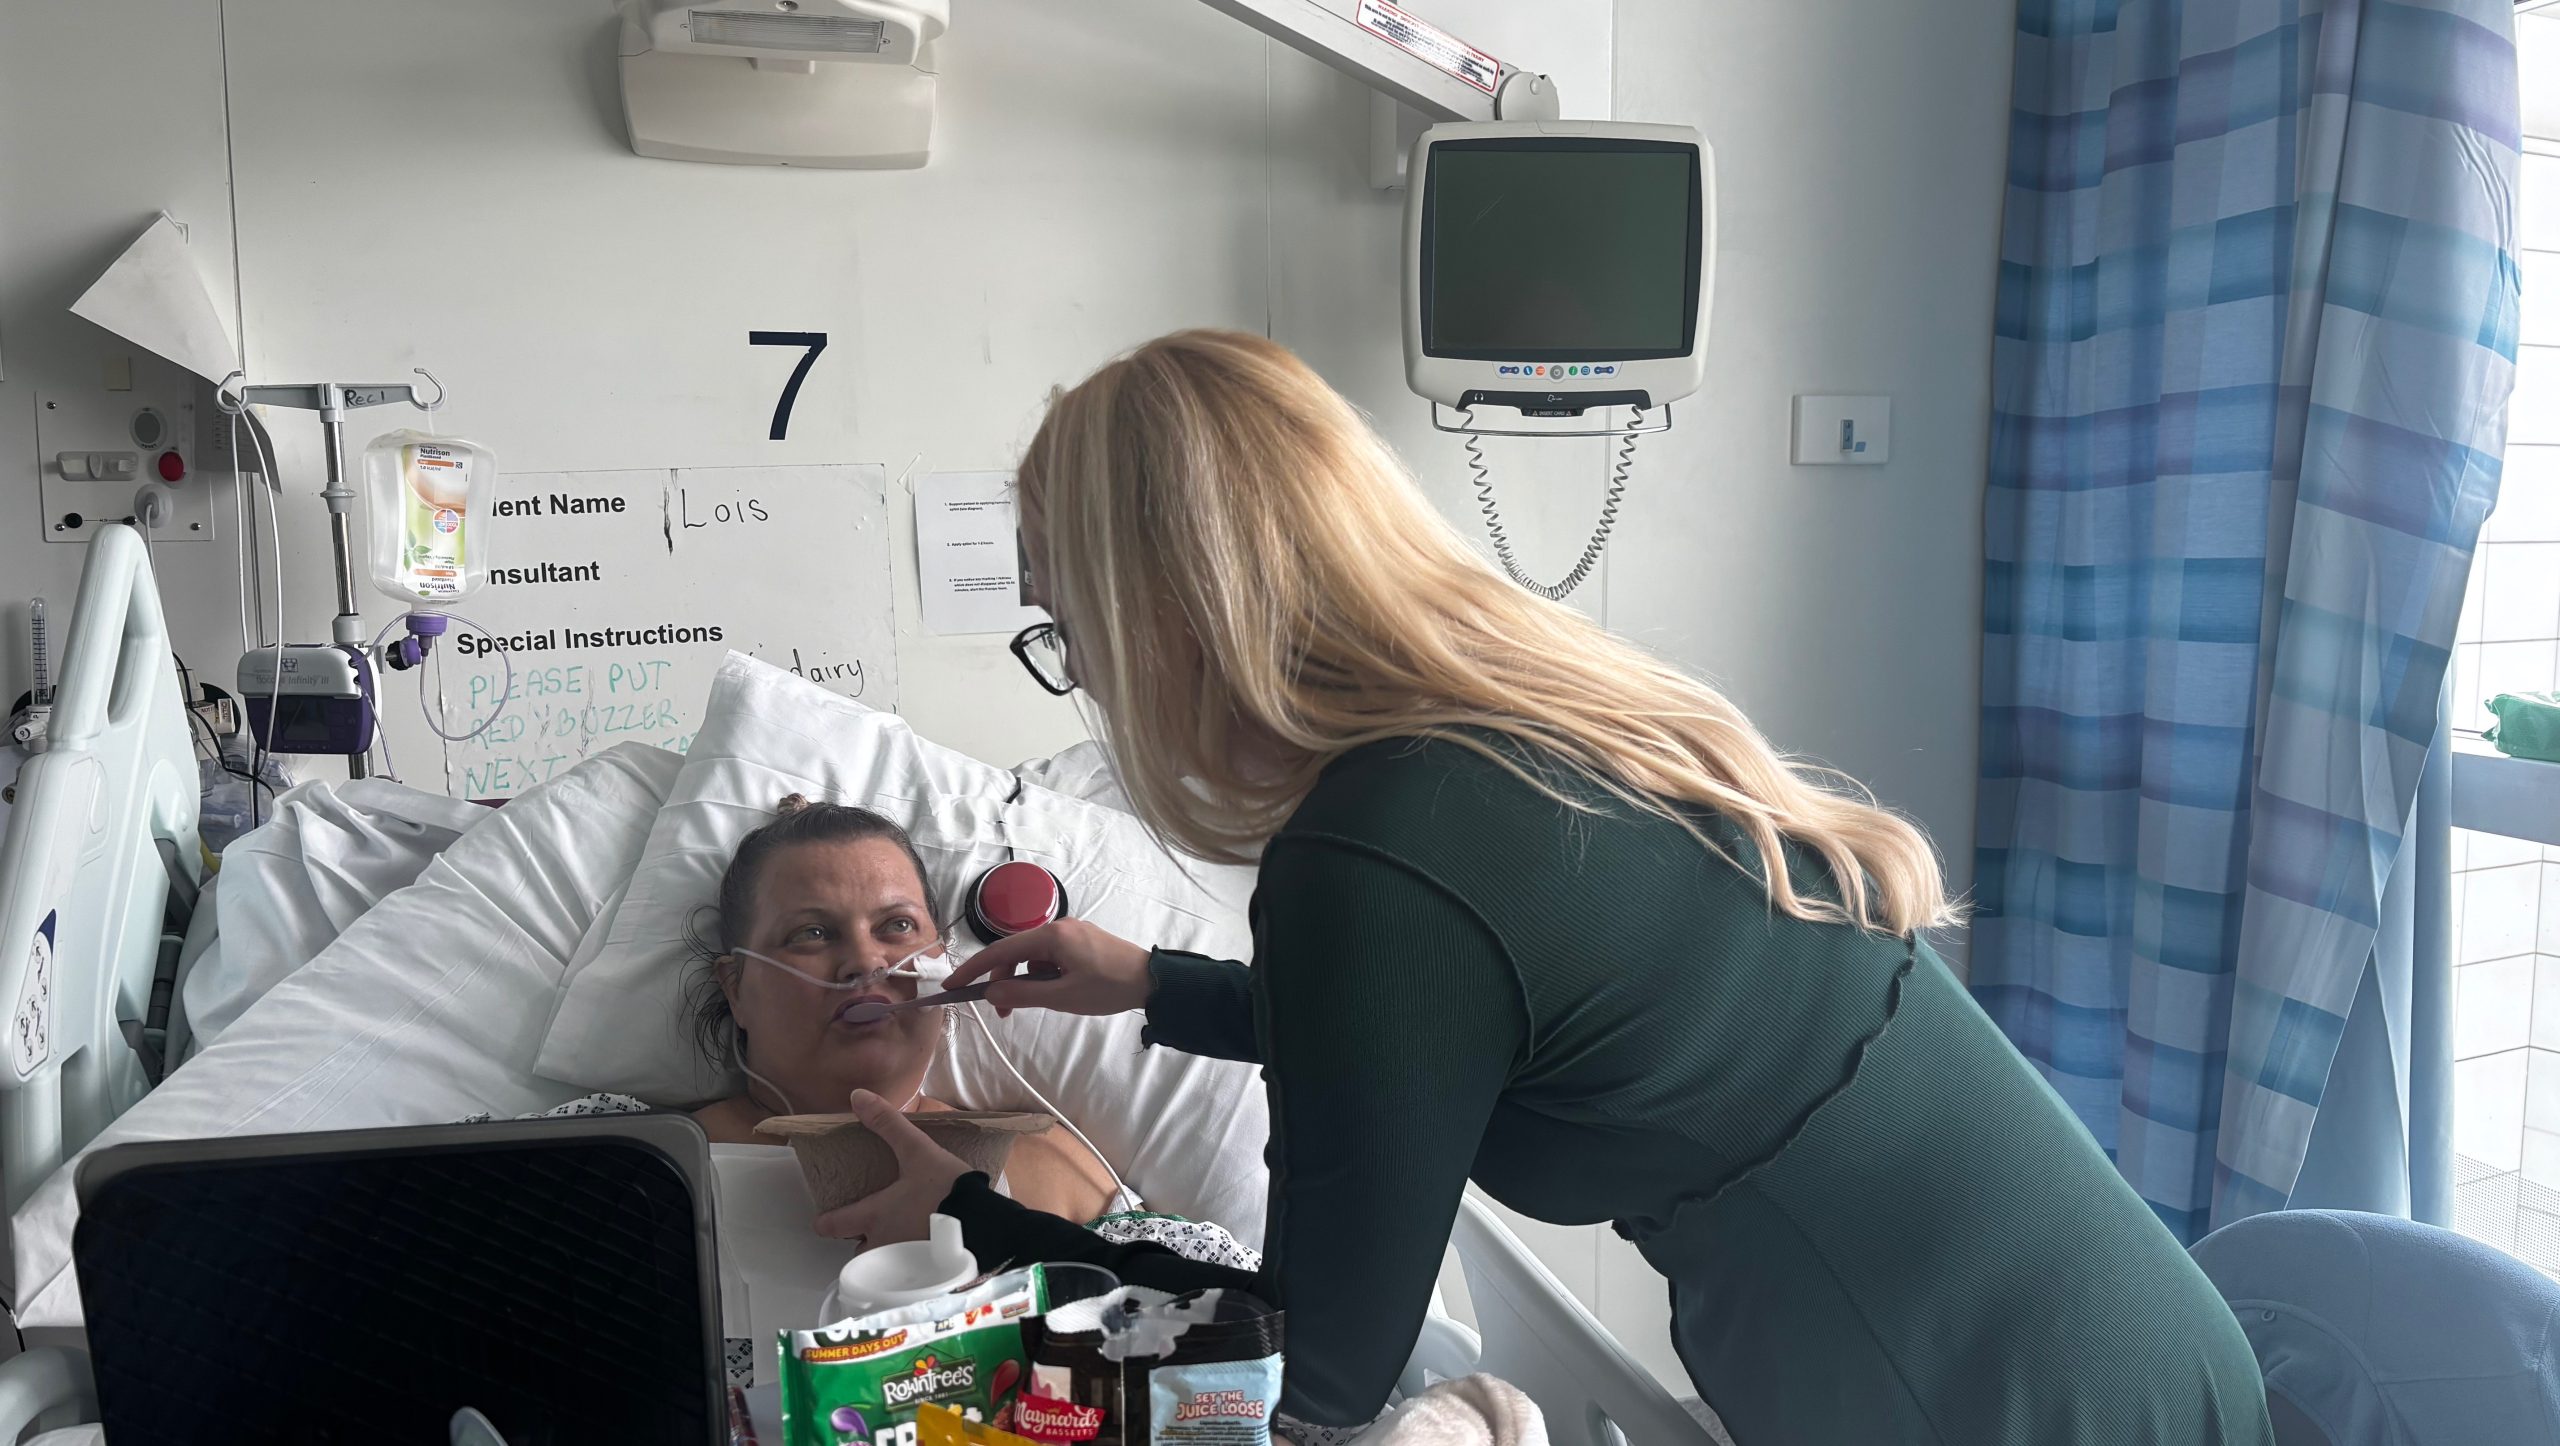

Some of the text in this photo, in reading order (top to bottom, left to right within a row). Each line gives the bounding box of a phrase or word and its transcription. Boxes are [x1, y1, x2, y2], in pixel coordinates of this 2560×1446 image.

[344, 389, 376, 408] Rec
[749, 331, 827, 441] 7
[420, 448, 450, 456] Nutrison
[492, 492, 626, 517] ient Name
[681, 488, 769, 529] Lois
[486, 561, 601, 585] nsultant
[420, 582, 455, 590] Nutrison
[457, 623, 724, 659] Special Instructions
[469, 660, 672, 710] PLEASE PUT
[789, 648, 865, 698] dairy
[470, 699, 679, 750] RED BUZZER
[465, 755, 567, 800] NEXT
[805, 1334, 906, 1359] SUMMER DAYS OUT
[1195, 1390, 1244, 1403] SET THE
[1014, 1401, 1101, 1433] Maynards
[1176, 1399, 1265, 1421] JUICE LOOSE
[1046, 1428, 1094, 1437] BASSETTS
